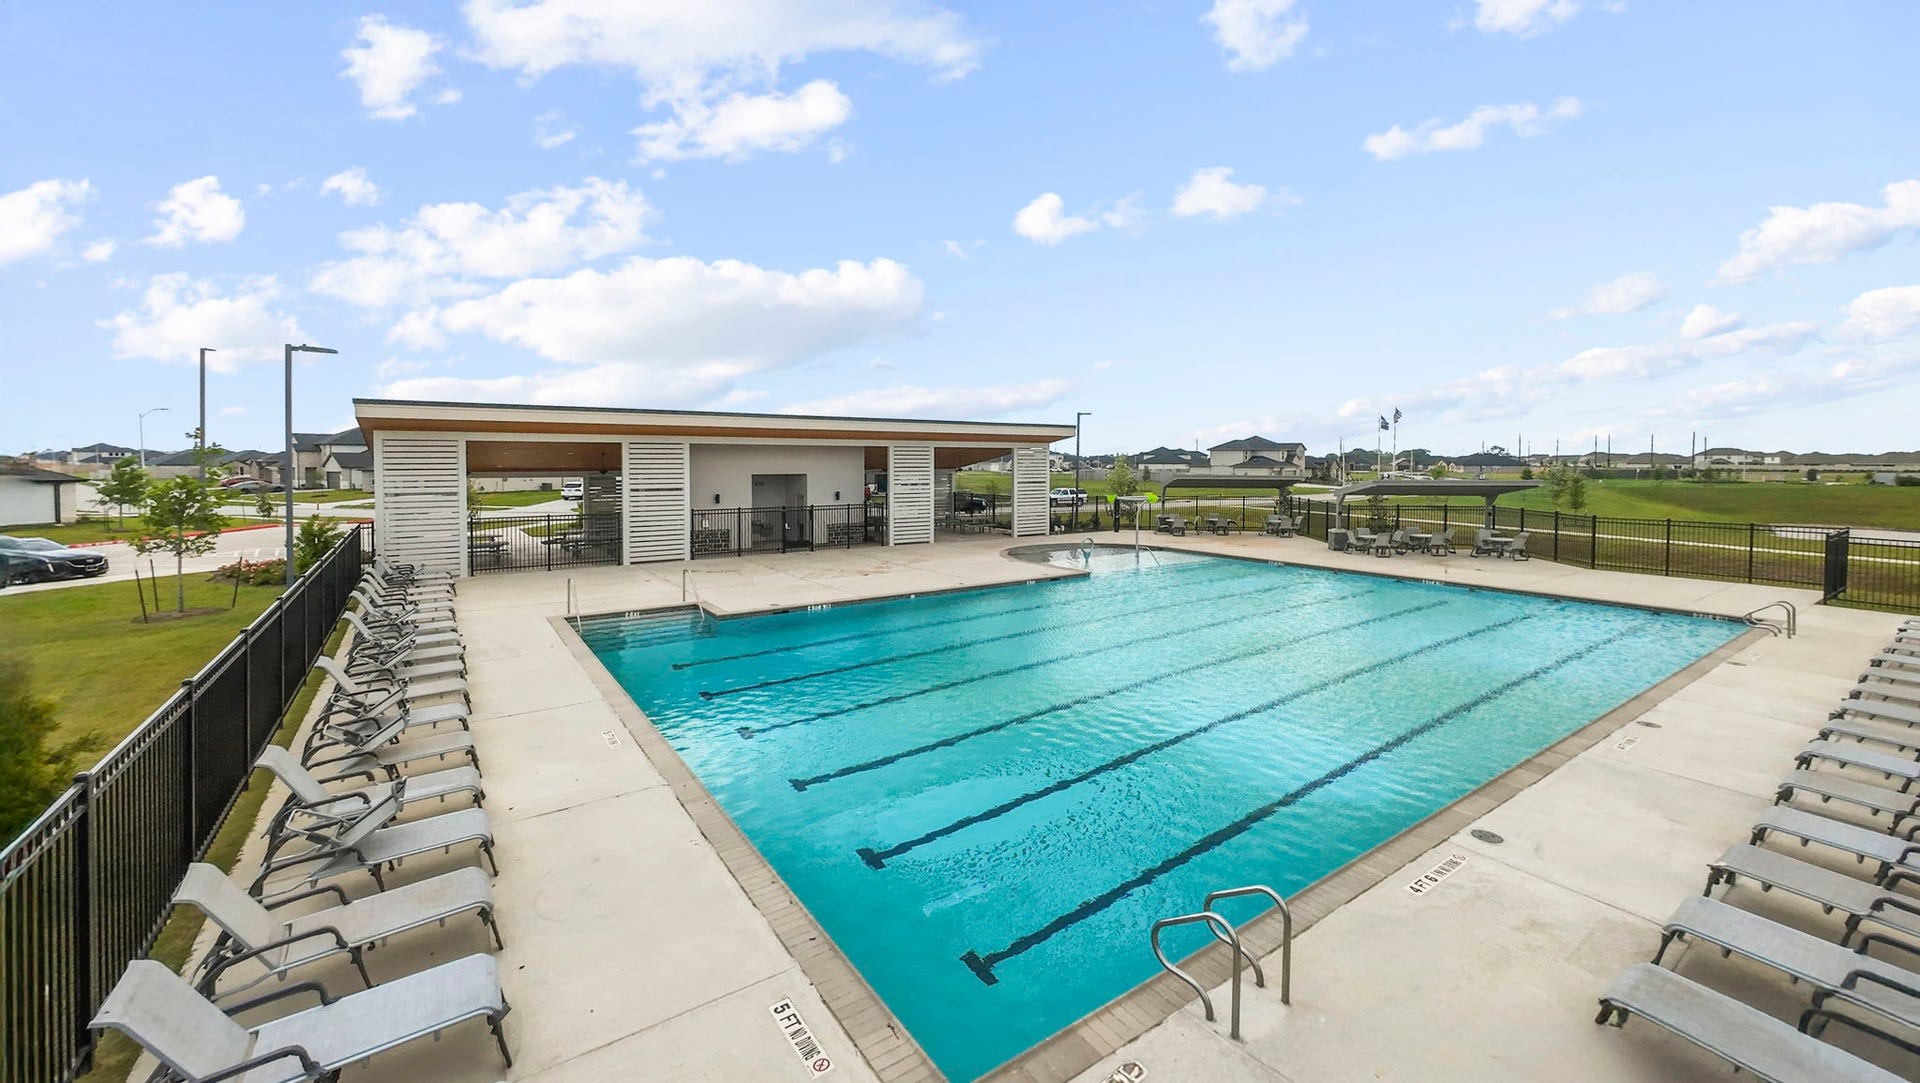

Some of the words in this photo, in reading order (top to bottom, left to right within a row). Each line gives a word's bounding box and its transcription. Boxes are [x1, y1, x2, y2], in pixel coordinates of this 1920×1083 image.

[1414, 879, 1431, 889] FT
[773, 1003, 791, 1014] 5
[780, 1013, 801, 1029] FT
[788, 1027, 808, 1040] NO
[794, 1036, 821, 1061] DIVING
